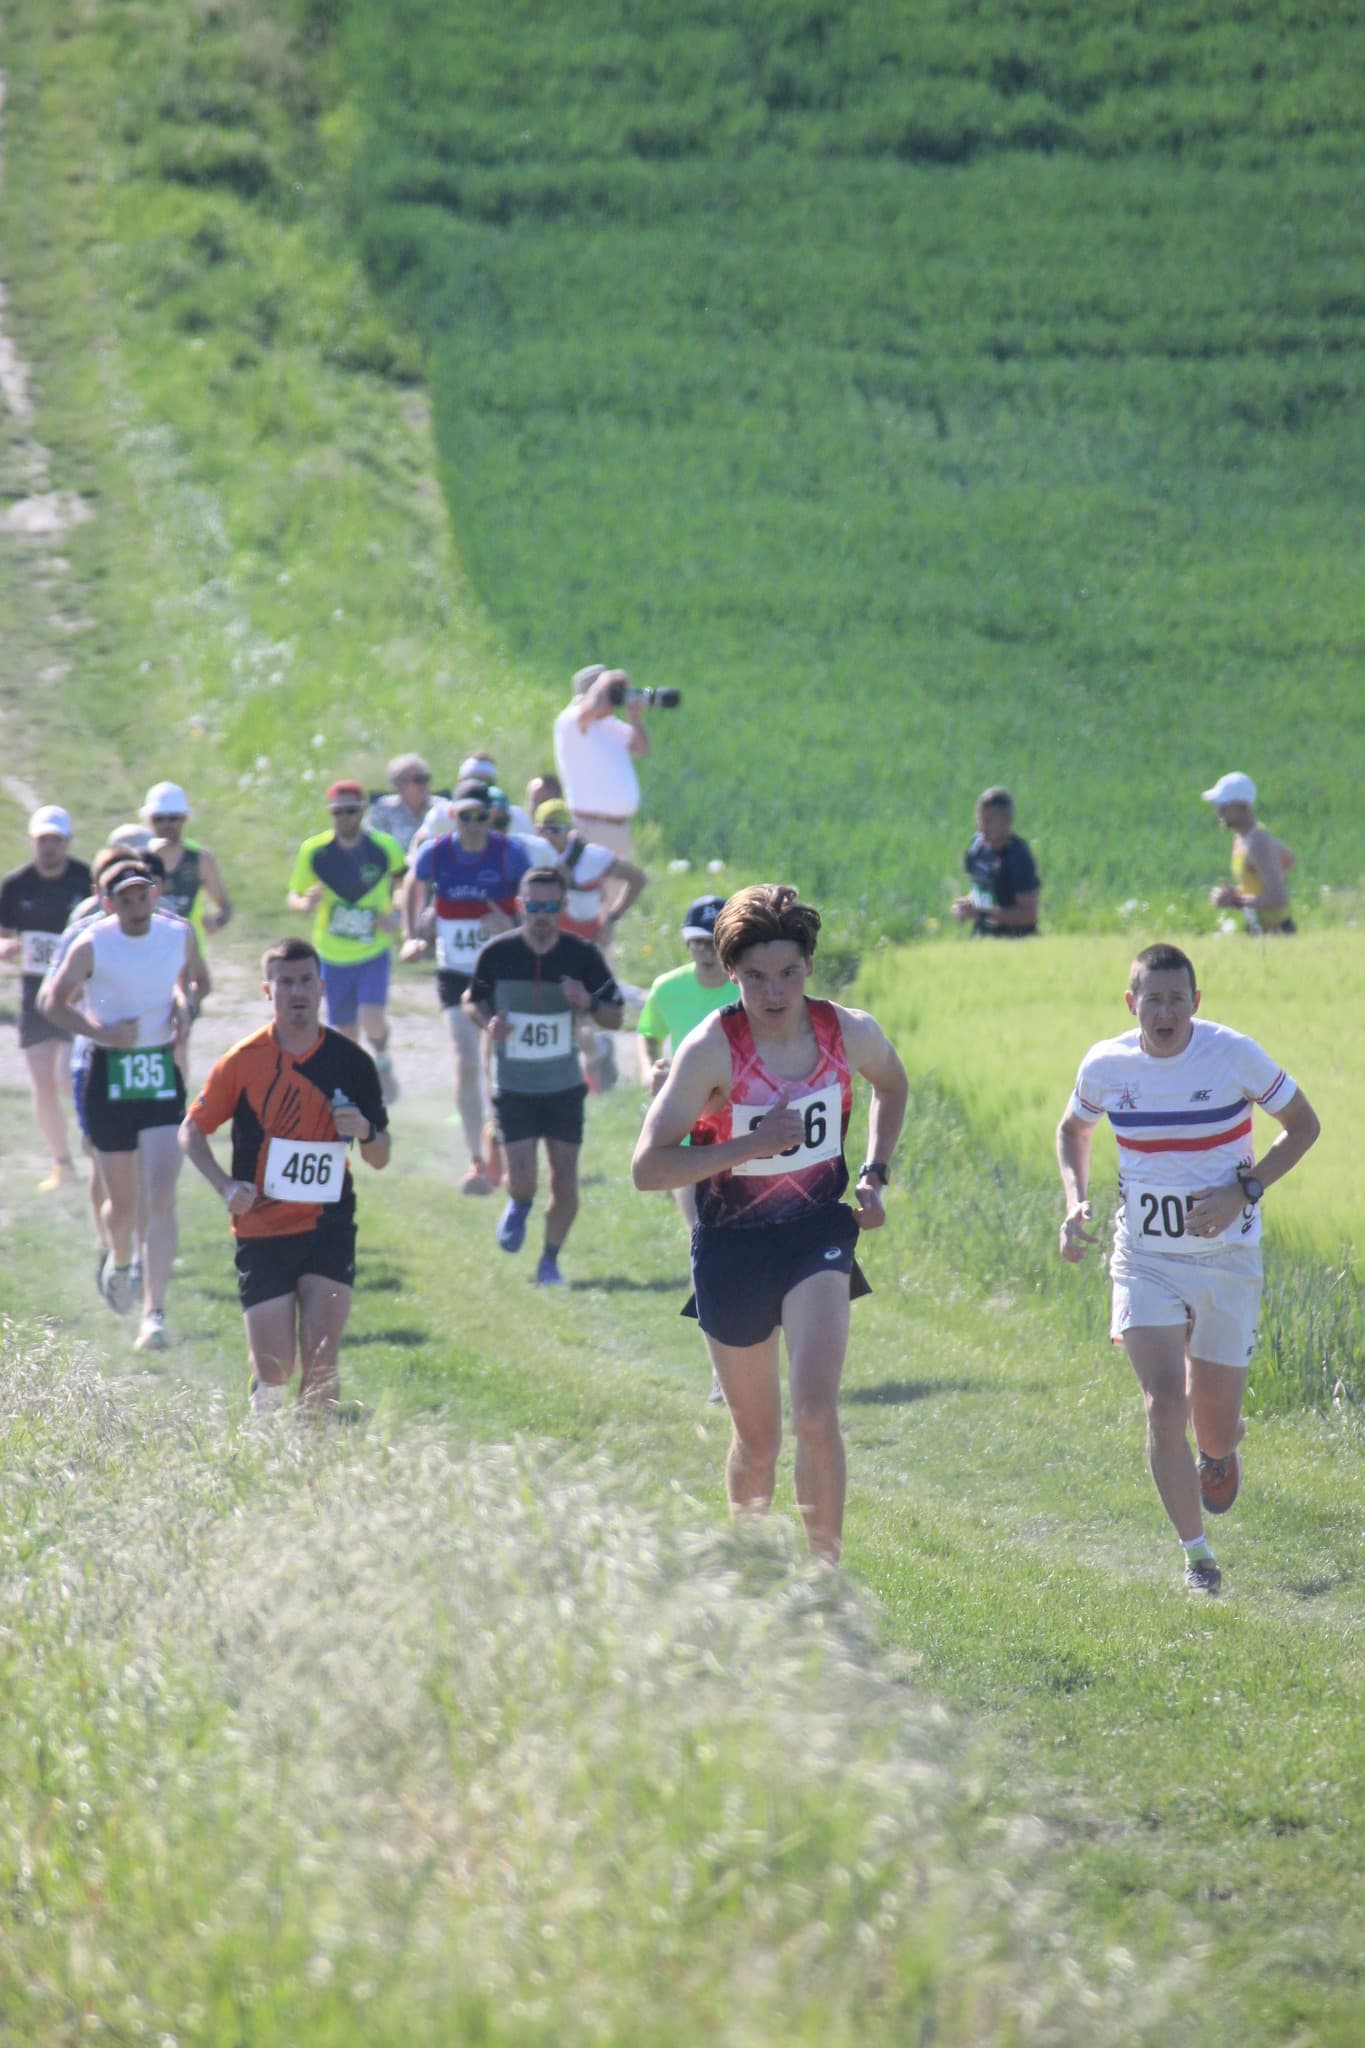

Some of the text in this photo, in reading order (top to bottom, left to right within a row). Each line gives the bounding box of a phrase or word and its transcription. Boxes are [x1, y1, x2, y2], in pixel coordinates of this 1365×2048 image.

[520, 1022, 559, 1047] 461
[120, 1054, 165, 1088] 135
[281, 1152, 332, 1185] 466
[1141, 1193, 1200, 1238] 20
